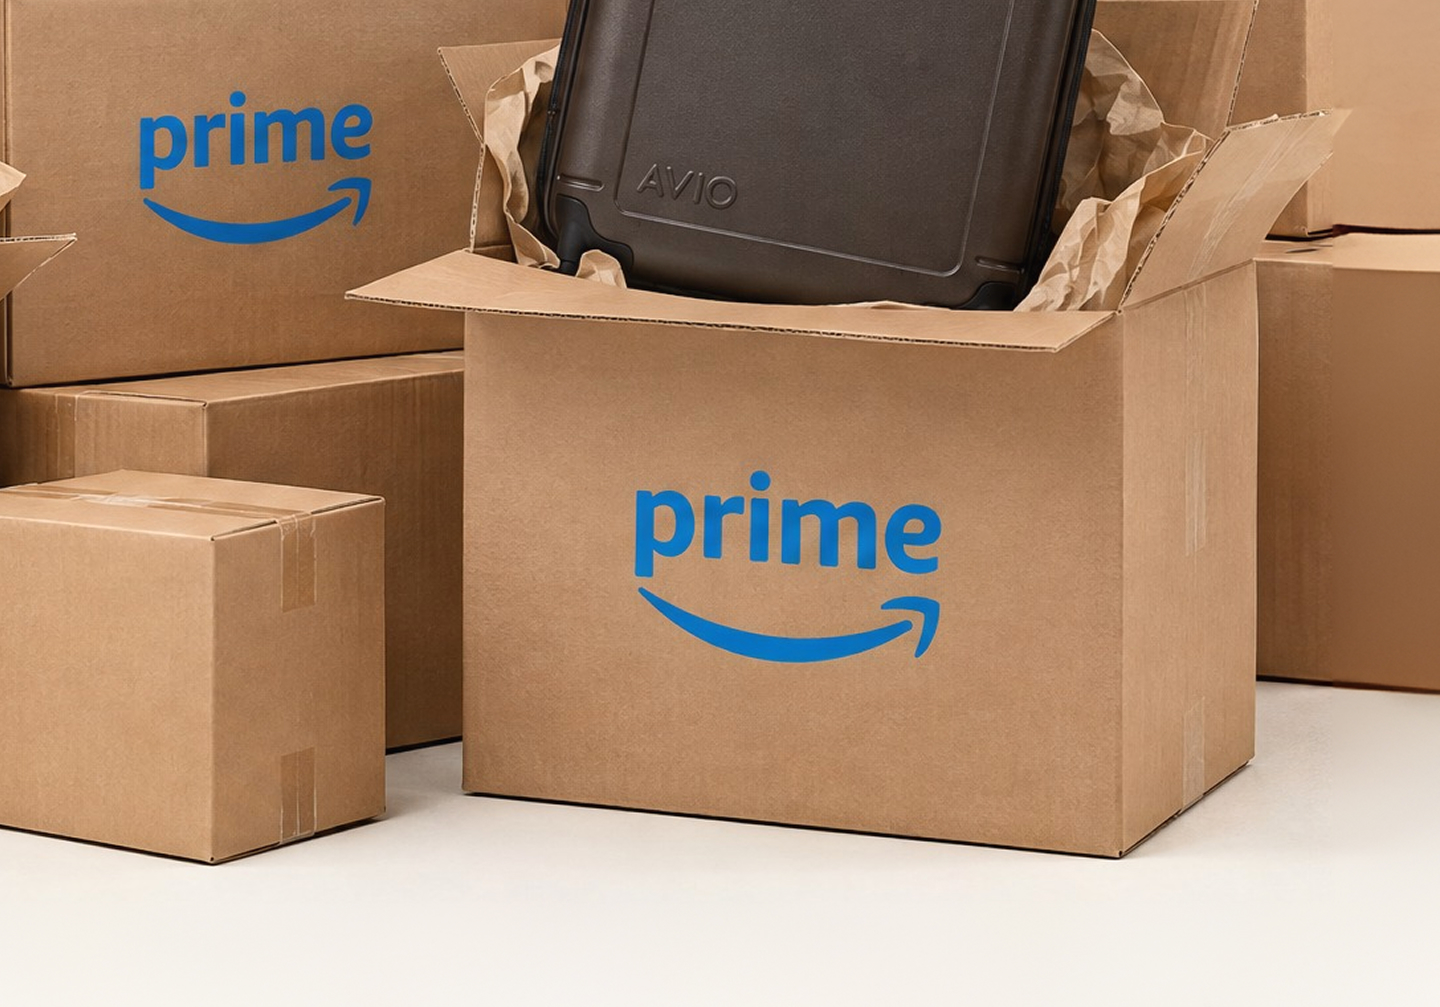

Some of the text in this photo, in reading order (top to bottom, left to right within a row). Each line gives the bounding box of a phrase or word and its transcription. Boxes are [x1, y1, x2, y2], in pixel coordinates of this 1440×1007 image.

[140, 91, 372, 189] prime
[636, 163, 738, 210] AVIO
[634, 470, 942, 578] prime
